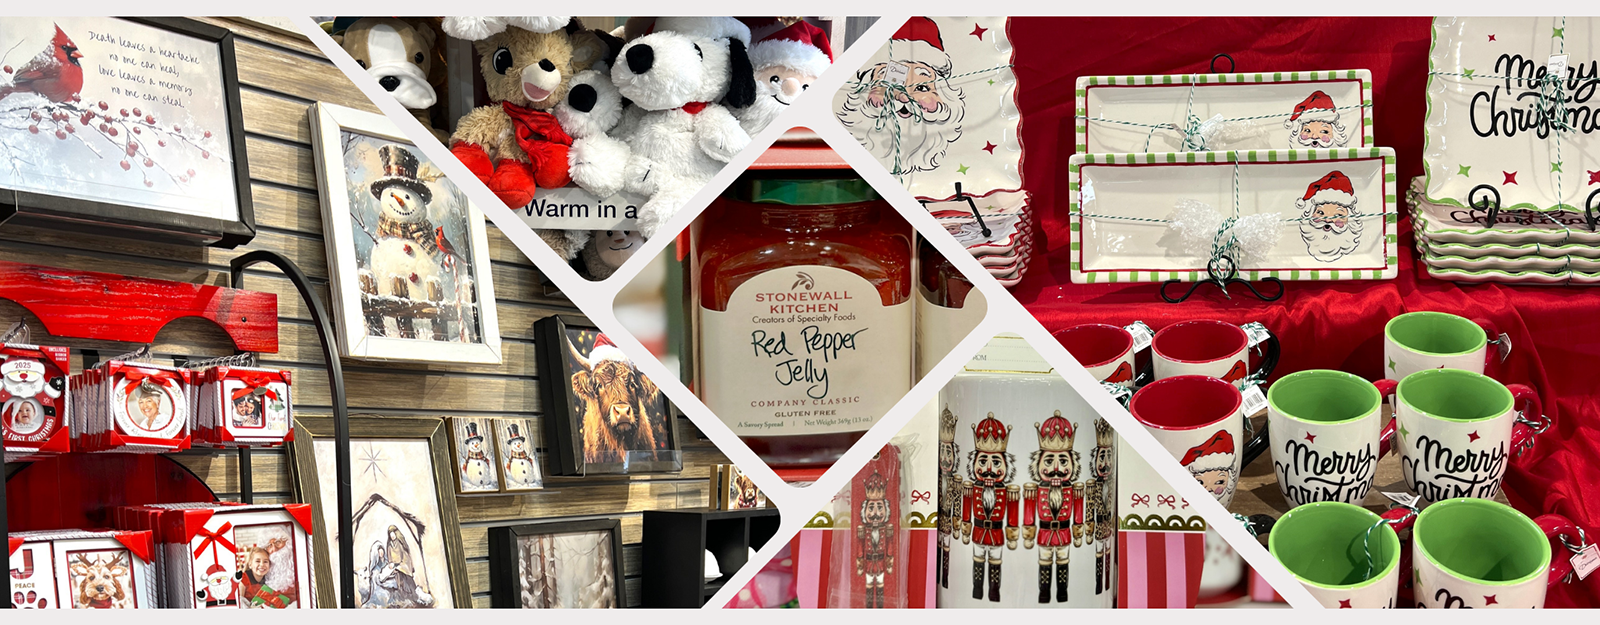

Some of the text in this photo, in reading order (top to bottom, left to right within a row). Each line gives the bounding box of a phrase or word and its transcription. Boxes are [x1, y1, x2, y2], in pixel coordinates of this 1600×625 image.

[88, 30, 200, 65] Death leaves a heartache
[108, 53, 180, 77] no one can heal,
[98, 63, 116, 77] love
[118, 69, 146, 84] leaves
[158, 80, 193, 97] memory
[1494, 53, 1600, 104] Mery
[111, 86, 185, 108] no one can steal.
[1470, 85, 1600, 139] Christma
[525, 198, 638, 219] Warm in a
[755, 290, 853, 302] STONEWALL
[751, 312, 856, 324] Creators of Specialty Foods
[769, 303, 839, 314] KITCHEN
[750, 325, 869, 363] Red Pepper
[775, 358, 829, 399] Jelly
[750, 396, 860, 408] COMPANY CLASSIC
[774, 410, 811, 418] GLUTEN
[8, 432, 26, 441] FIRST
[28, 418, 54, 442] CHRISTMAS
[763, 421, 784, 429] Spread
[815, 419, 837, 427] Weight
[1285, 439, 1376, 481] Merry
[1416, 435, 1508, 480] Merry
[9, 548, 34, 580] J
